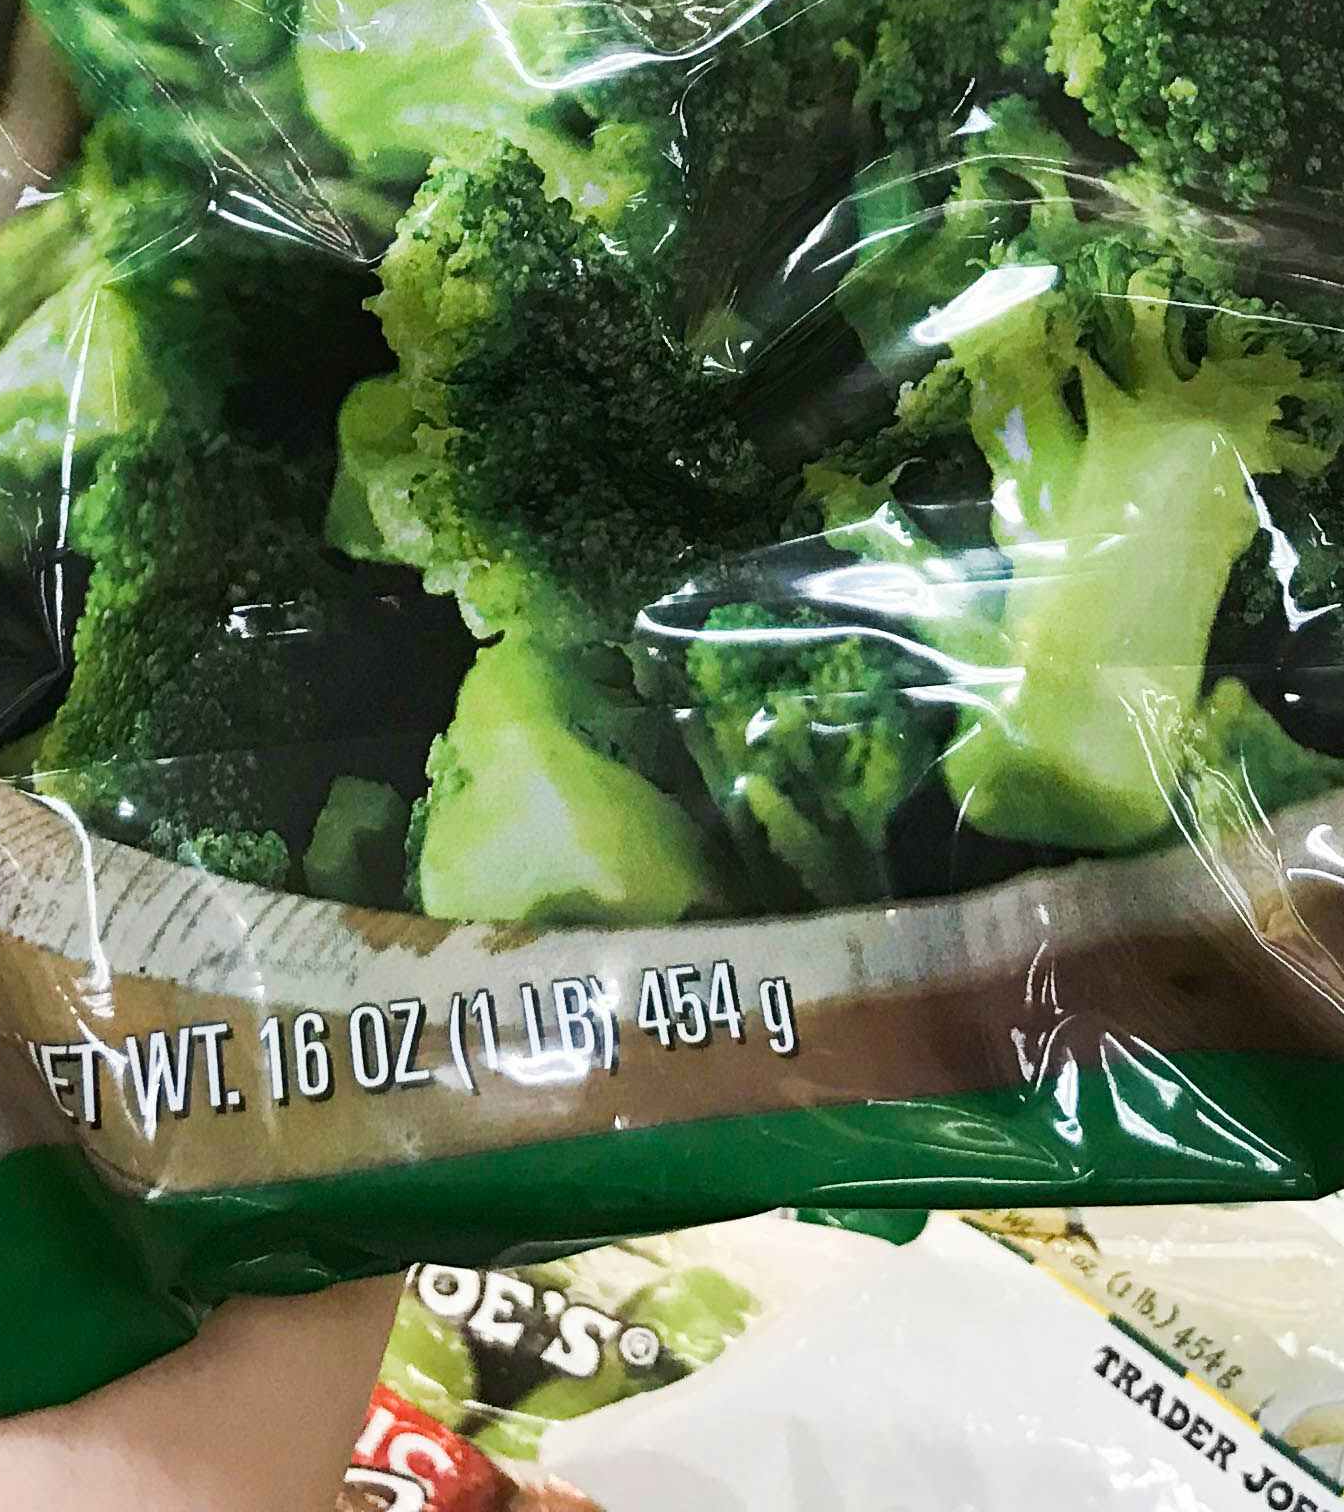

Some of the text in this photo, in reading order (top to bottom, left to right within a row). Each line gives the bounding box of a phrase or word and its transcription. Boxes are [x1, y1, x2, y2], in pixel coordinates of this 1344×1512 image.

[27, 1040, 102, 1130] ET
[124, 1021, 248, 1126] WT.
[259, 1007, 334, 1108] 16
[349, 998, 436, 1090] OZ
[449, 991, 500, 1096] (1
[637, 958, 747, 1053] 454
[759, 974, 800, 1059] g
[1093, 1343, 1239, 1472] TRADER
